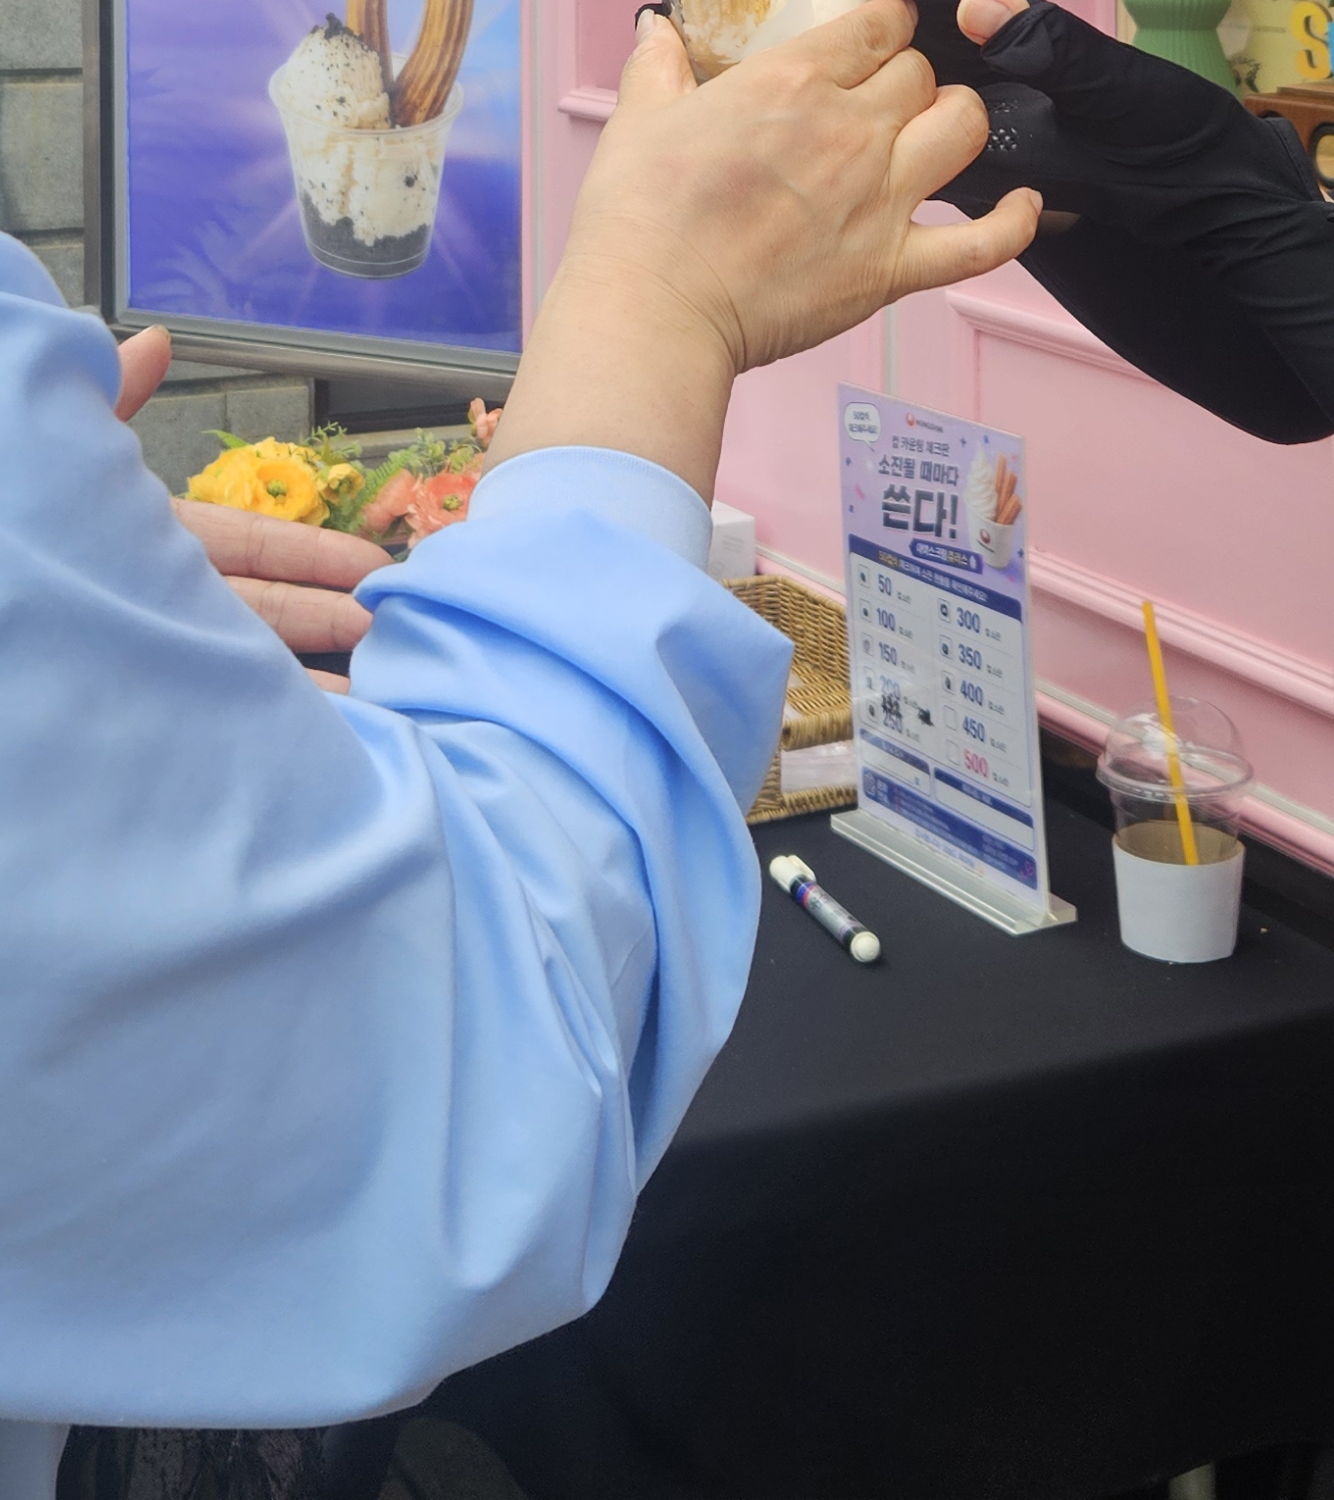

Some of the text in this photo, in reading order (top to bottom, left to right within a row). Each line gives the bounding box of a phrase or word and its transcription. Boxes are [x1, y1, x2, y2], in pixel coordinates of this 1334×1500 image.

[901, 436, 924, 453] 카운팅
[878, 454, 960, 487] 소진될 때마다
[882, 483, 959, 539] 쓴다!
[878, 573, 892, 597] 50
[876, 607, 897, 632] 100
[957, 607, 981, 634] 300
[879, 641, 899, 666] 150
[958, 643, 983, 671] 350
[879, 675, 901, 701] 200
[960, 680, 984, 707] 400
[962, 716, 986, 743] 450
[964, 748, 989, 778] 500
